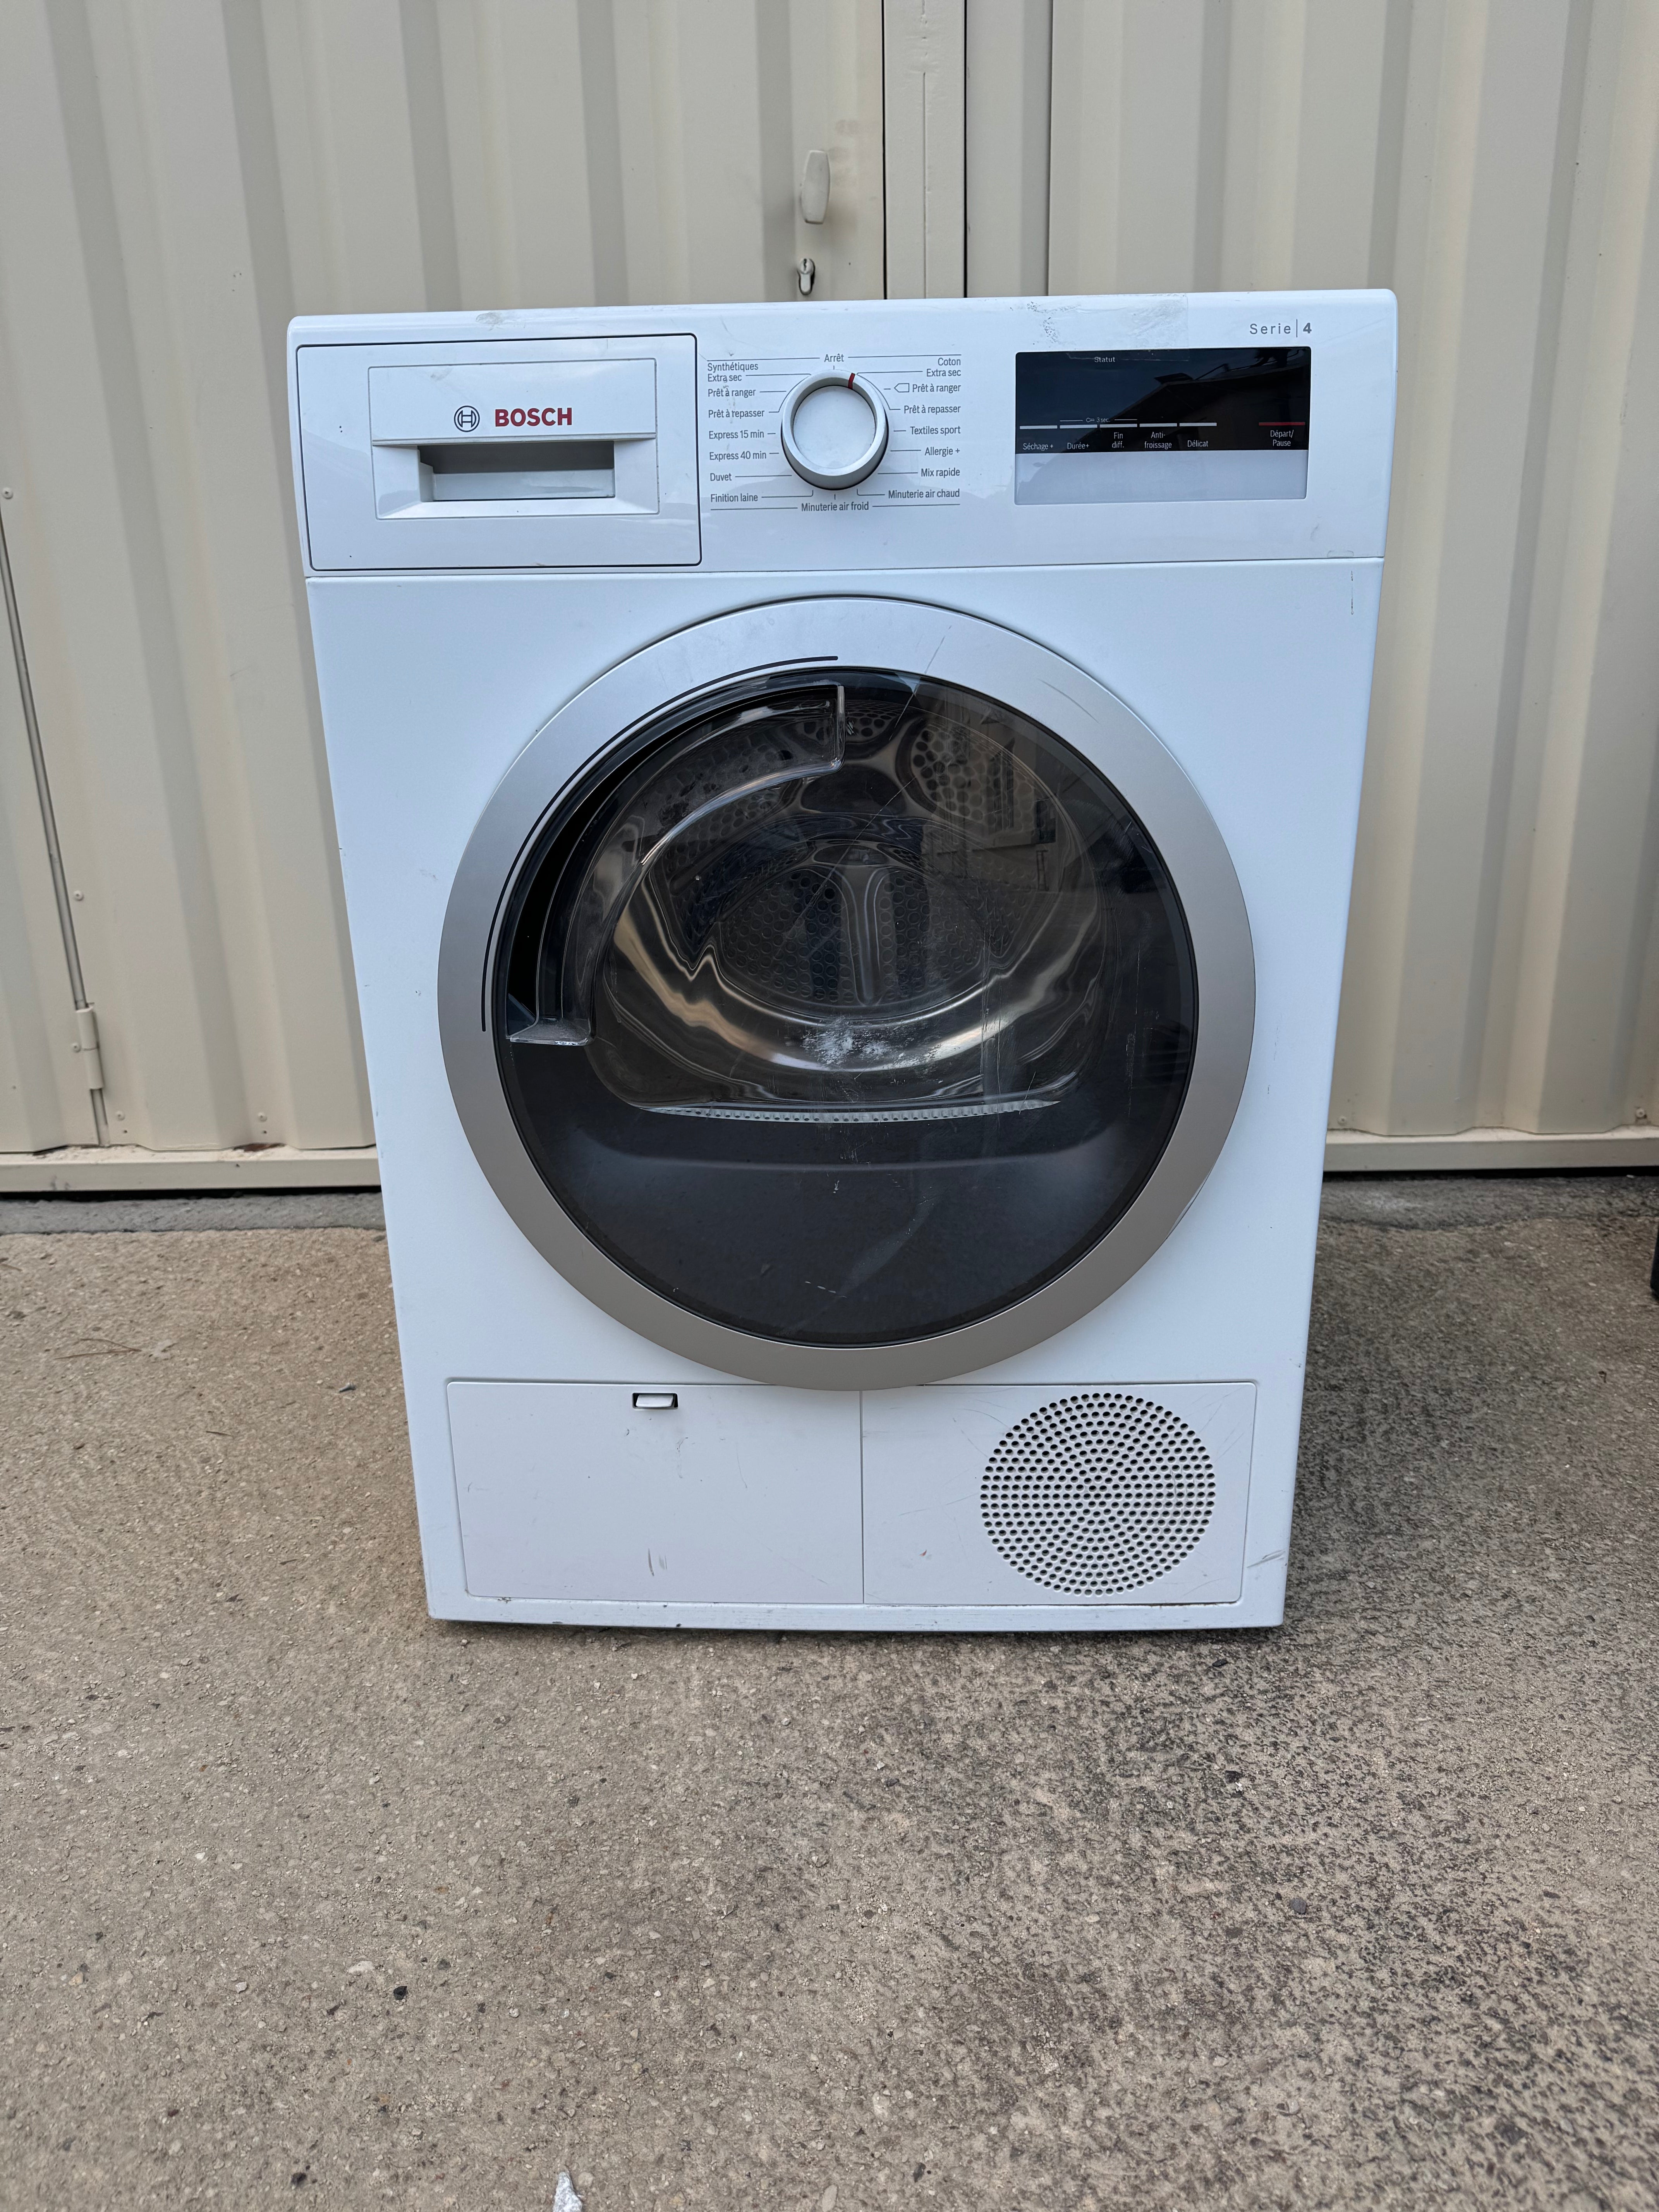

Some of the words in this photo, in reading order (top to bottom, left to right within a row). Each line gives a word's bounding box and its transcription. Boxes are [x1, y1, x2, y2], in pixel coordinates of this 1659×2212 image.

[1250, 323, 1291, 334] Serie
[1303, 323, 1312, 333] 4
[824, 354, 844, 362] Arrêt
[938, 357, 961, 366] Coton
[708, 363, 758, 373] Synthétiques
[927, 369, 946, 377] Extra
[708, 374, 727, 382] Extra
[912, 384, 927, 392] Prêt
[936, 385, 961, 393] ranger
[732, 389, 756, 398] ranger
[904, 405, 920, 414] Prêt
[922, 405, 926, 413] à
[928, 406, 961, 414] repasser
[495, 407, 572, 427] BOSCH
[708, 410, 723, 418] Prêt
[732, 410, 764, 419] repasser
[709, 430, 738, 440] Express
[740, 430, 749, 438] 15
[910, 426, 938, 434] Textiles
[940, 426, 960, 436] sport
[1270, 430, 1293, 438] Départ/
[1145, 441, 1172, 450] froissage
[709, 452, 738, 462] Express
[740, 451, 750, 459] 40
[925, 447, 953, 457] Allergie
[710, 473, 732, 481] Duvet
[921, 469, 934, 477] Mix
[936, 468, 960, 477] rapide
[711, 494, 738, 502] Finition
[888, 490, 924, 498] Minuterie
[926, 489, 935, 498] air
[937, 489, 960, 498] chaud
[802, 502, 837, 512] Minuterie
[839, 502, 849, 511] air
[851, 502, 869, 510] froid
